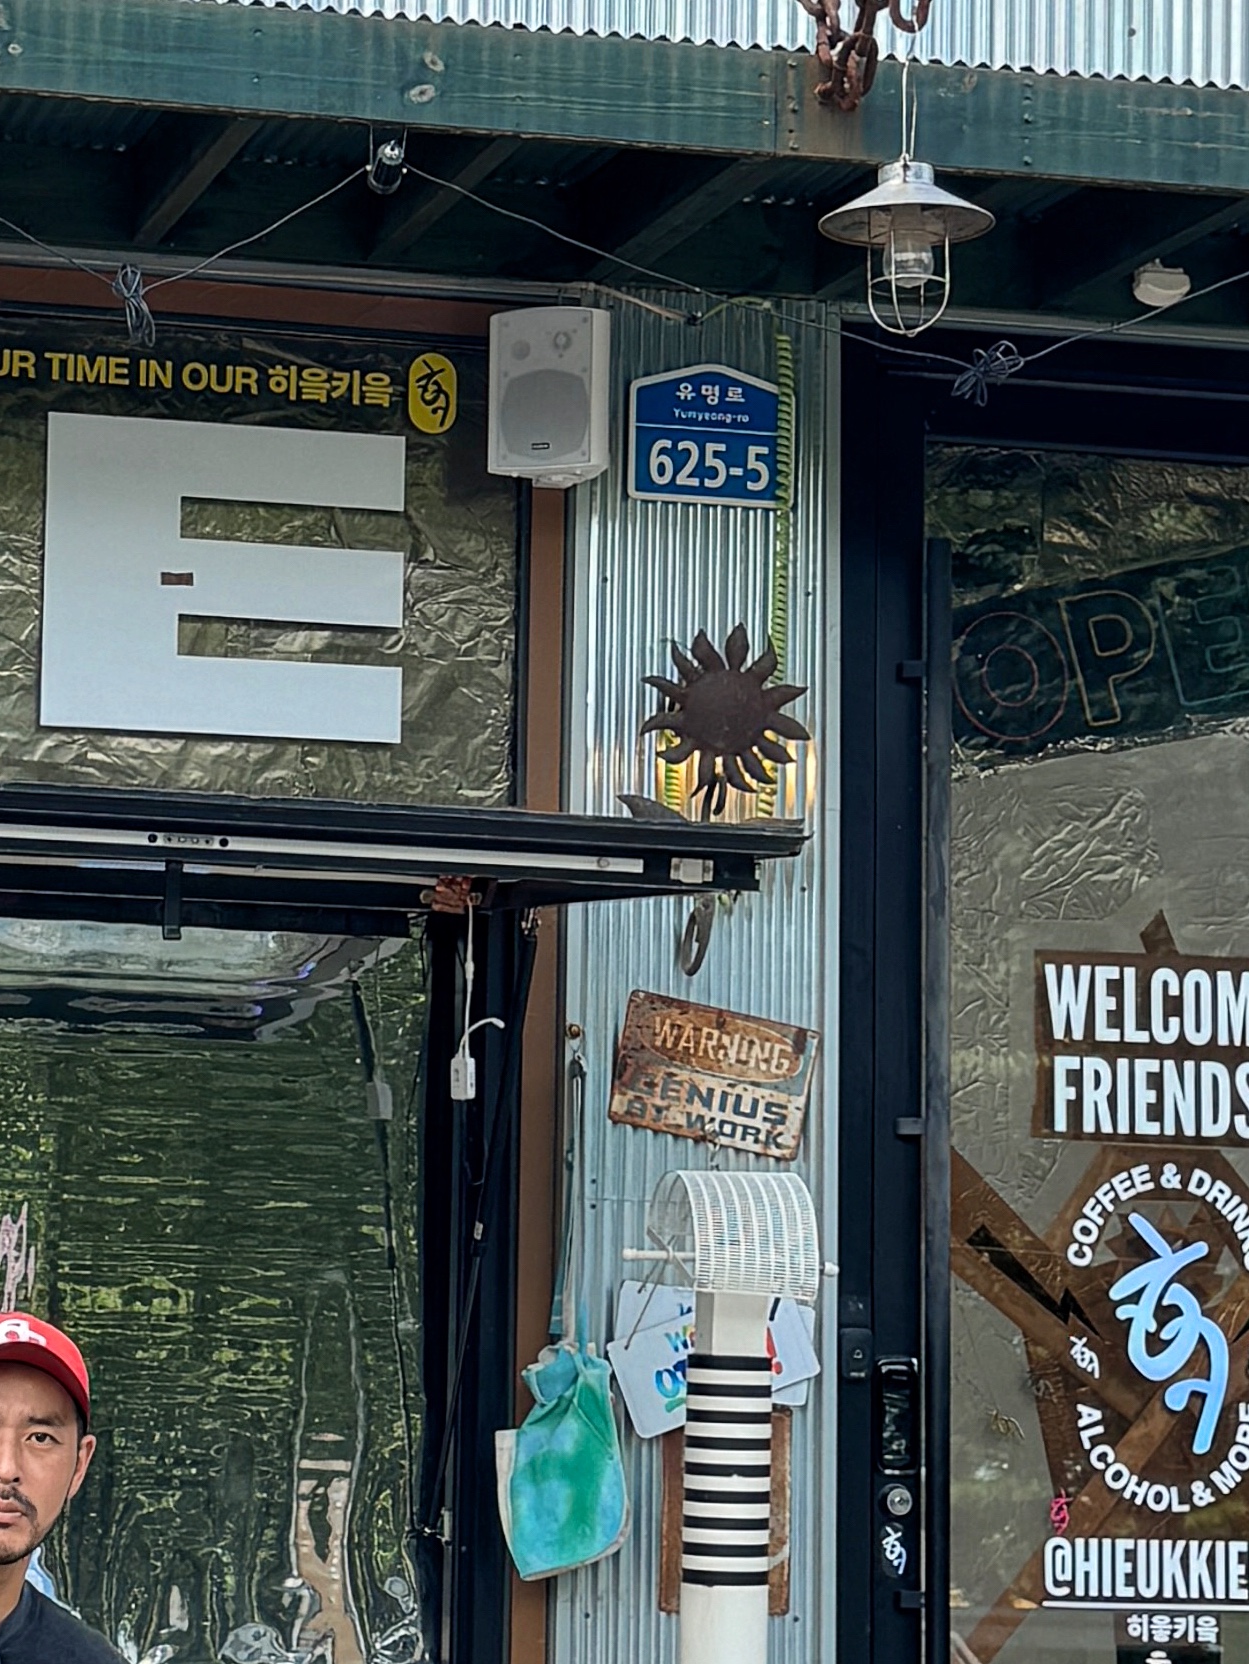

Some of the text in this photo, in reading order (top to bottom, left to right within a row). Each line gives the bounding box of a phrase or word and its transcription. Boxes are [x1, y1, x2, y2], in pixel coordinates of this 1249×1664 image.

[44, 351, 130, 386] TIME
[139, 358, 173, 389] IN
[182, 361, 259, 396] OUR
[649, 438, 770, 492] 625-5
[654, 1015, 791, 1075] WARNING
[635, 1070, 789, 1126] GENIUS
[685, 1110, 790, 1150] WORK
[1067, 1164, 1155, 1268] COFFEE
[1159, 1162, 1183, 1190] &
[1076, 1403, 1191, 1513] ALCOHOL
[1190, 1480, 1217, 1508] &
